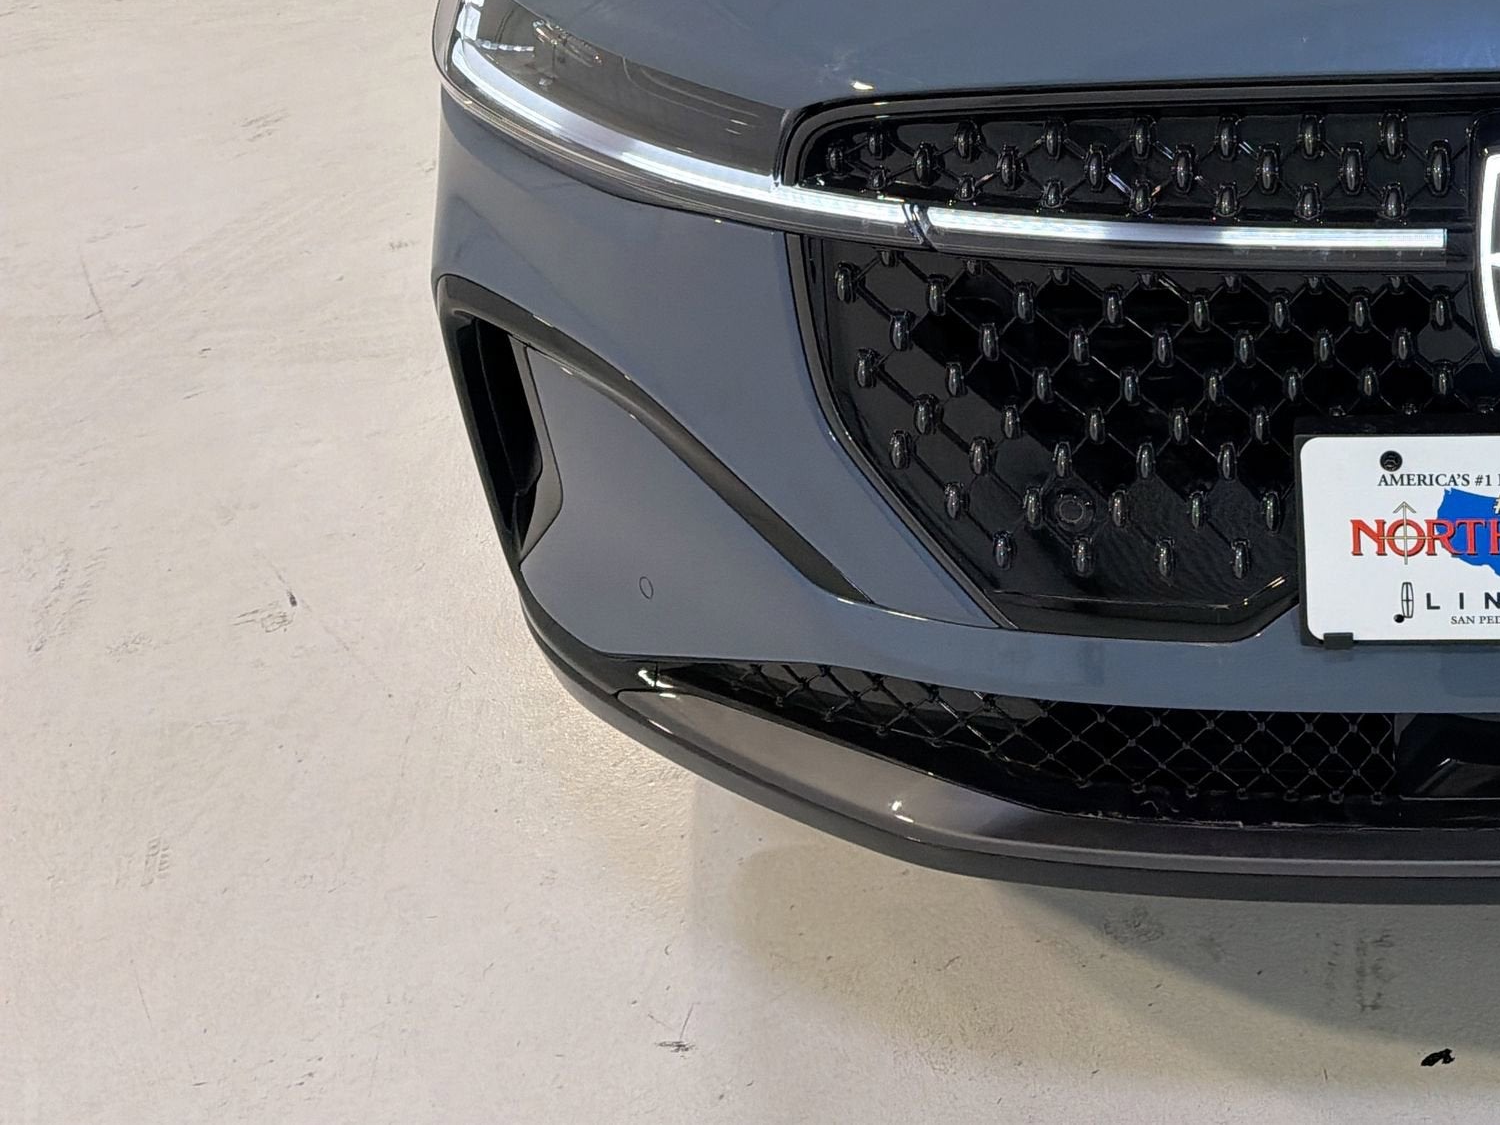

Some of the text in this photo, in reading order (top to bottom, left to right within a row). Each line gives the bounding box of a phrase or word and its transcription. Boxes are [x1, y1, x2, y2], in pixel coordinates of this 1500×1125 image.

[1377, 473, 1470, 487] AMERICA'S
[1475, 473, 1492, 487] #1
[1450, 615, 1475, 625] SAN
